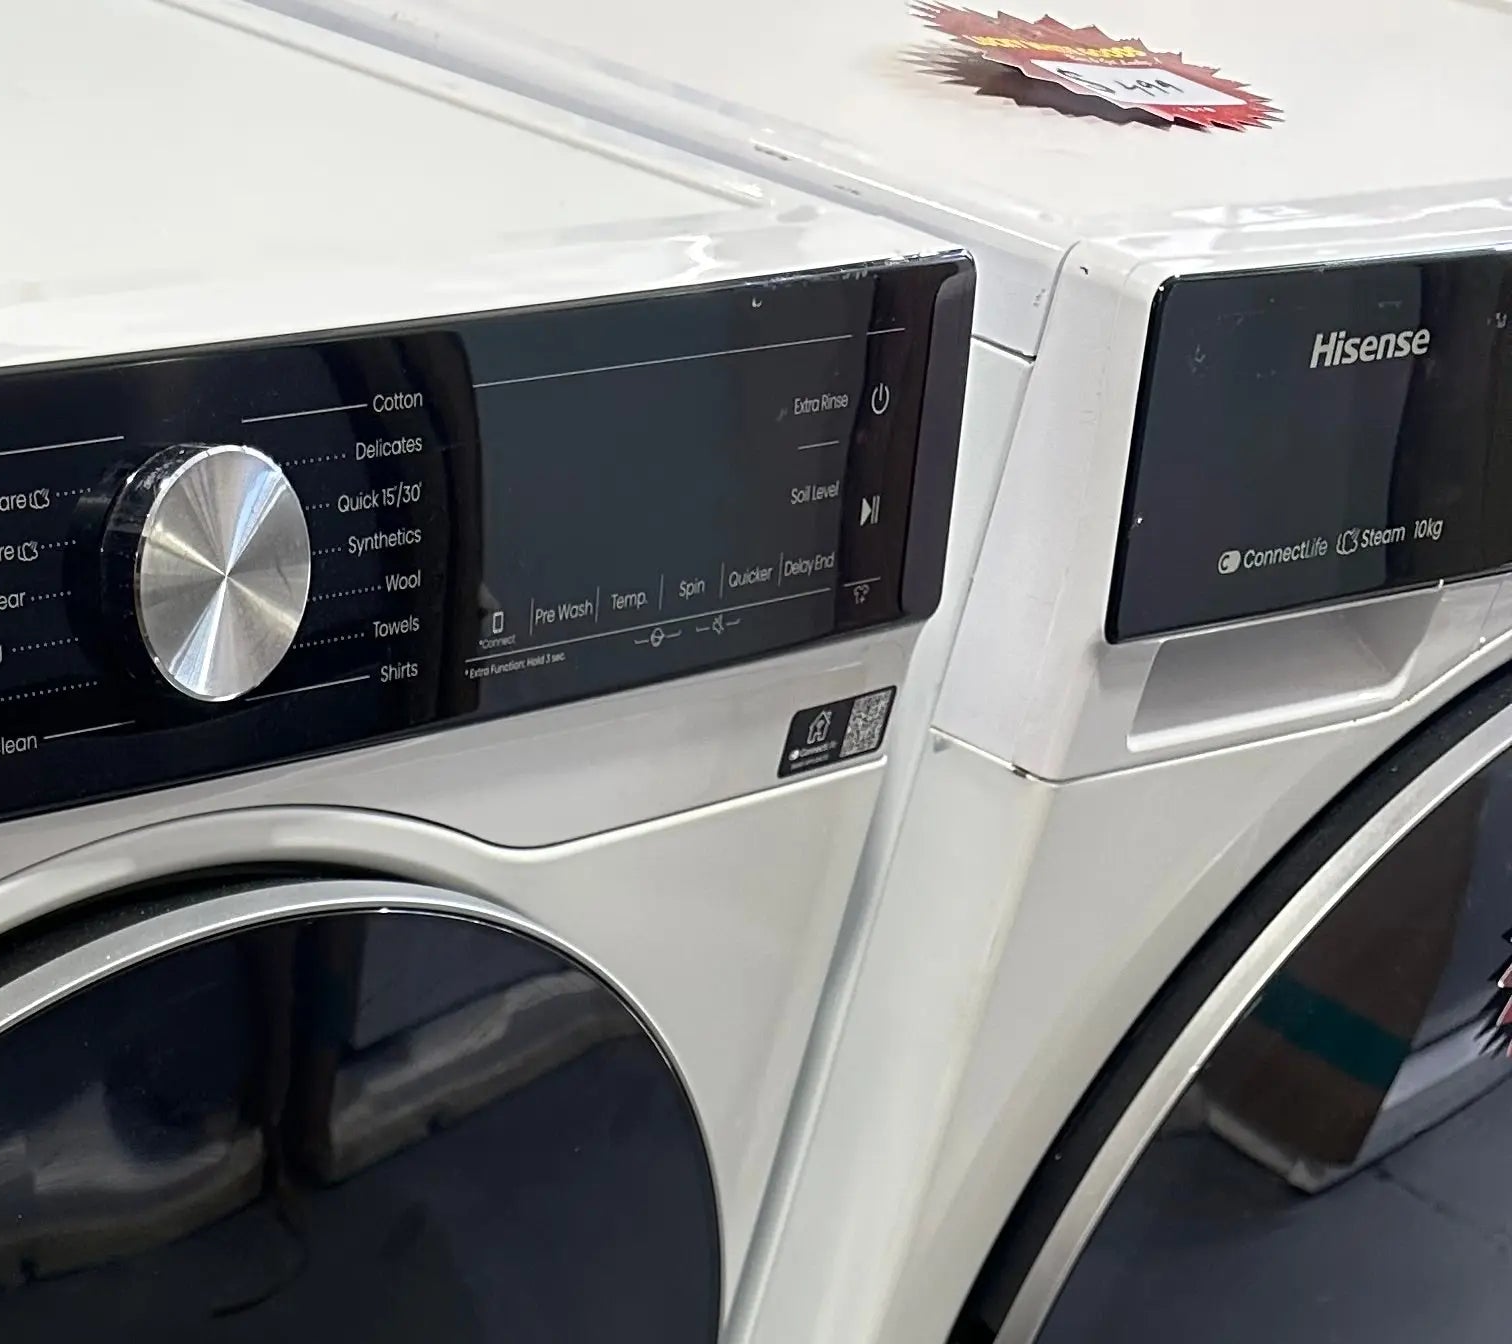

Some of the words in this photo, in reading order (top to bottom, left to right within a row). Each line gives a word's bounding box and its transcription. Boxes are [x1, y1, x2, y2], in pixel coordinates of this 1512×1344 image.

[1309, 328, 1431, 368] Hisense
[372, 392, 423, 412] Cotton
[793, 398, 820, 415] Extra
[821, 393, 848, 411] Rinse
[355, 437, 423, 460] Delicates
[337, 490, 379, 513] Quick
[790, 485, 812, 505] Soil
[812, 480, 840, 501] Level
[348, 527, 422, 557] Synthetics
[1243, 537, 1328, 568] ConnectLife
[1361, 524, 1406, 548] Steam
[1414, 518, 1444, 541] 10kg
[785, 556, 814, 577] Delay
[815, 552, 835, 570] End
[385, 570, 421, 591] Wool
[729, 566, 773, 588] Quicker
[679, 579, 705, 599] Spin
[610, 591, 647, 611] Temp.
[535, 608, 556, 625] Pre
[558, 601, 593, 621] Wash
[373, 615, 420, 639] Towels
[380, 661, 418, 683] Shirts
[469, 667, 489, 679] Extra
[527, 655, 545, 667] Hold
